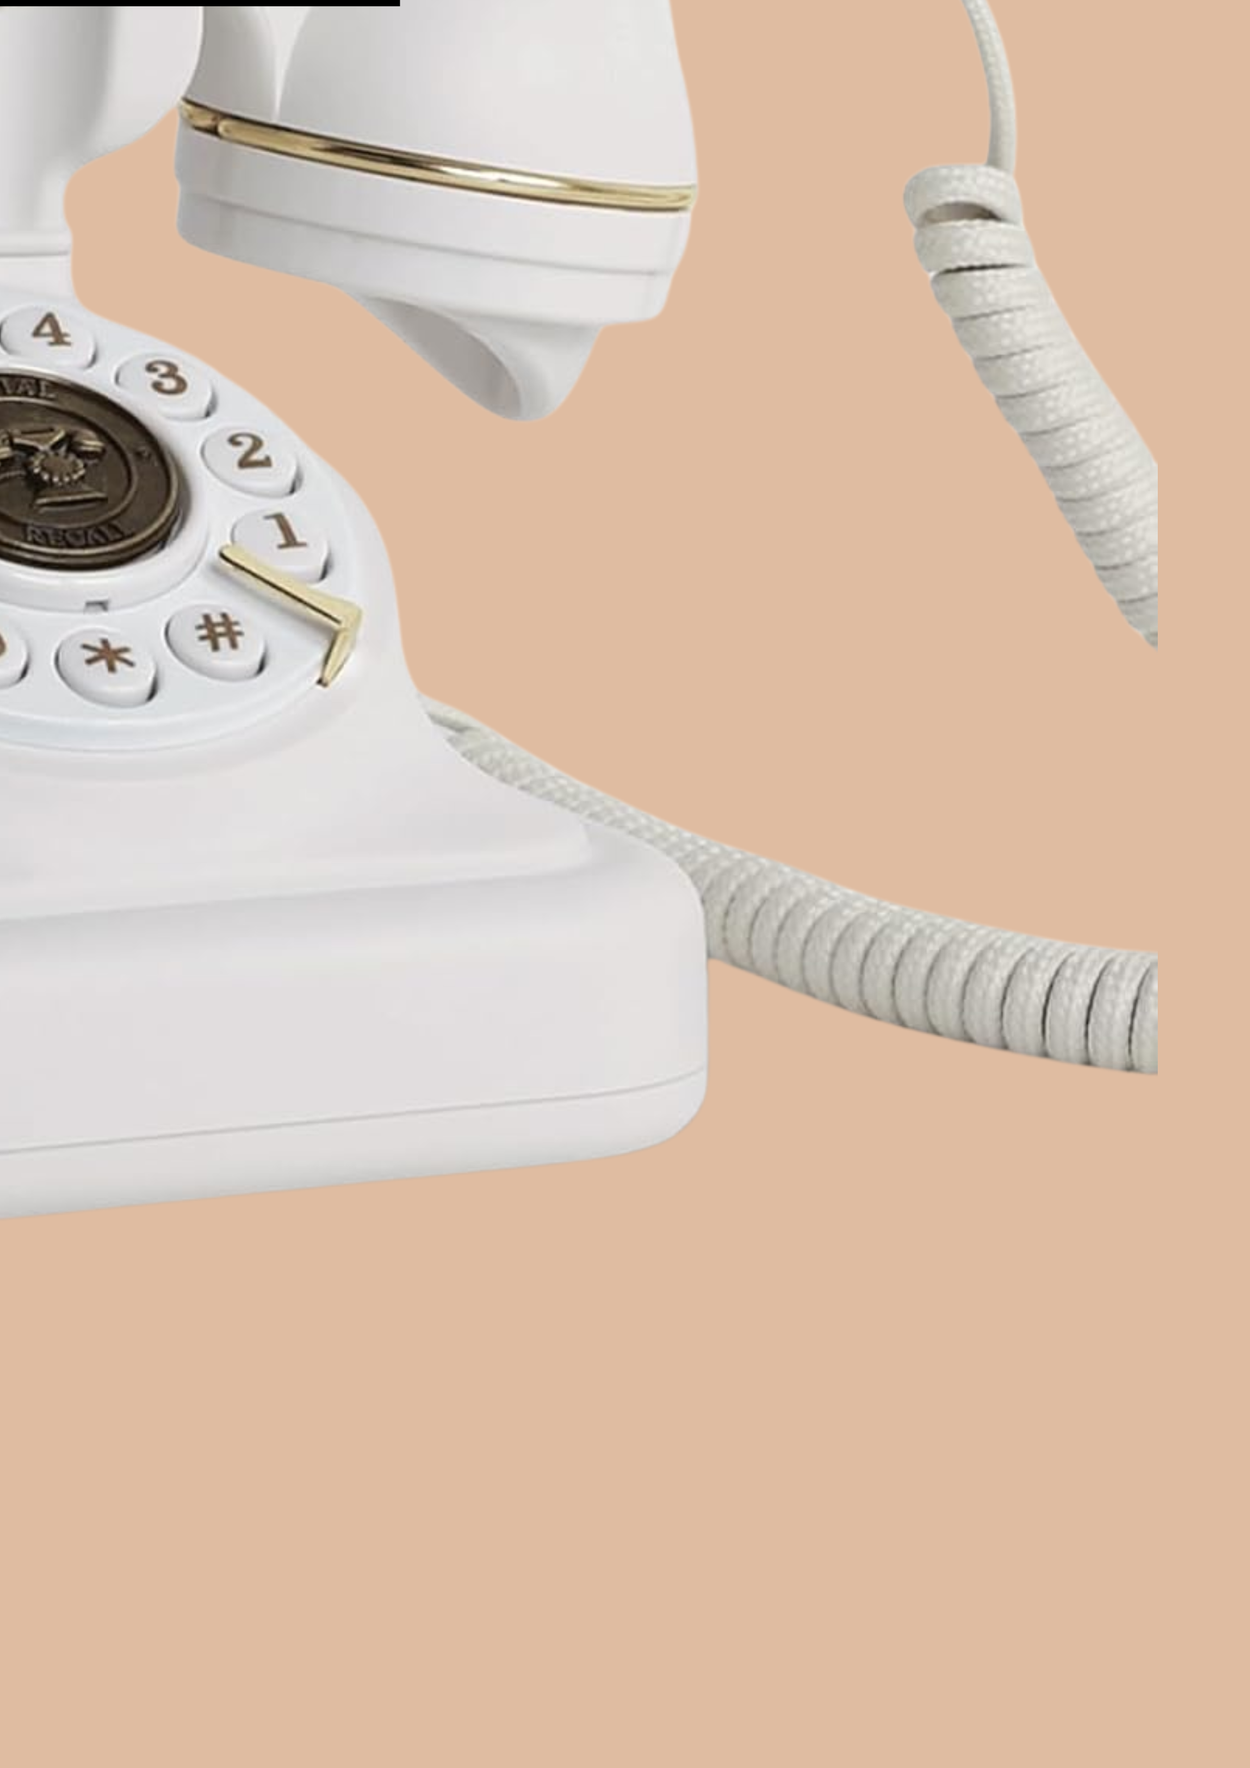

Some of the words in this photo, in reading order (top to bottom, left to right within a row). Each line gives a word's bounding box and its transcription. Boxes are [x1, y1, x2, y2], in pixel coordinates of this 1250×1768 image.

[31, 312, 72, 347] 4
[144, 360, 188, 396] 3
[227, 432, 272, 470] 2
[263, 512, 307, 550] 1
[195, 612, 244, 652] #
